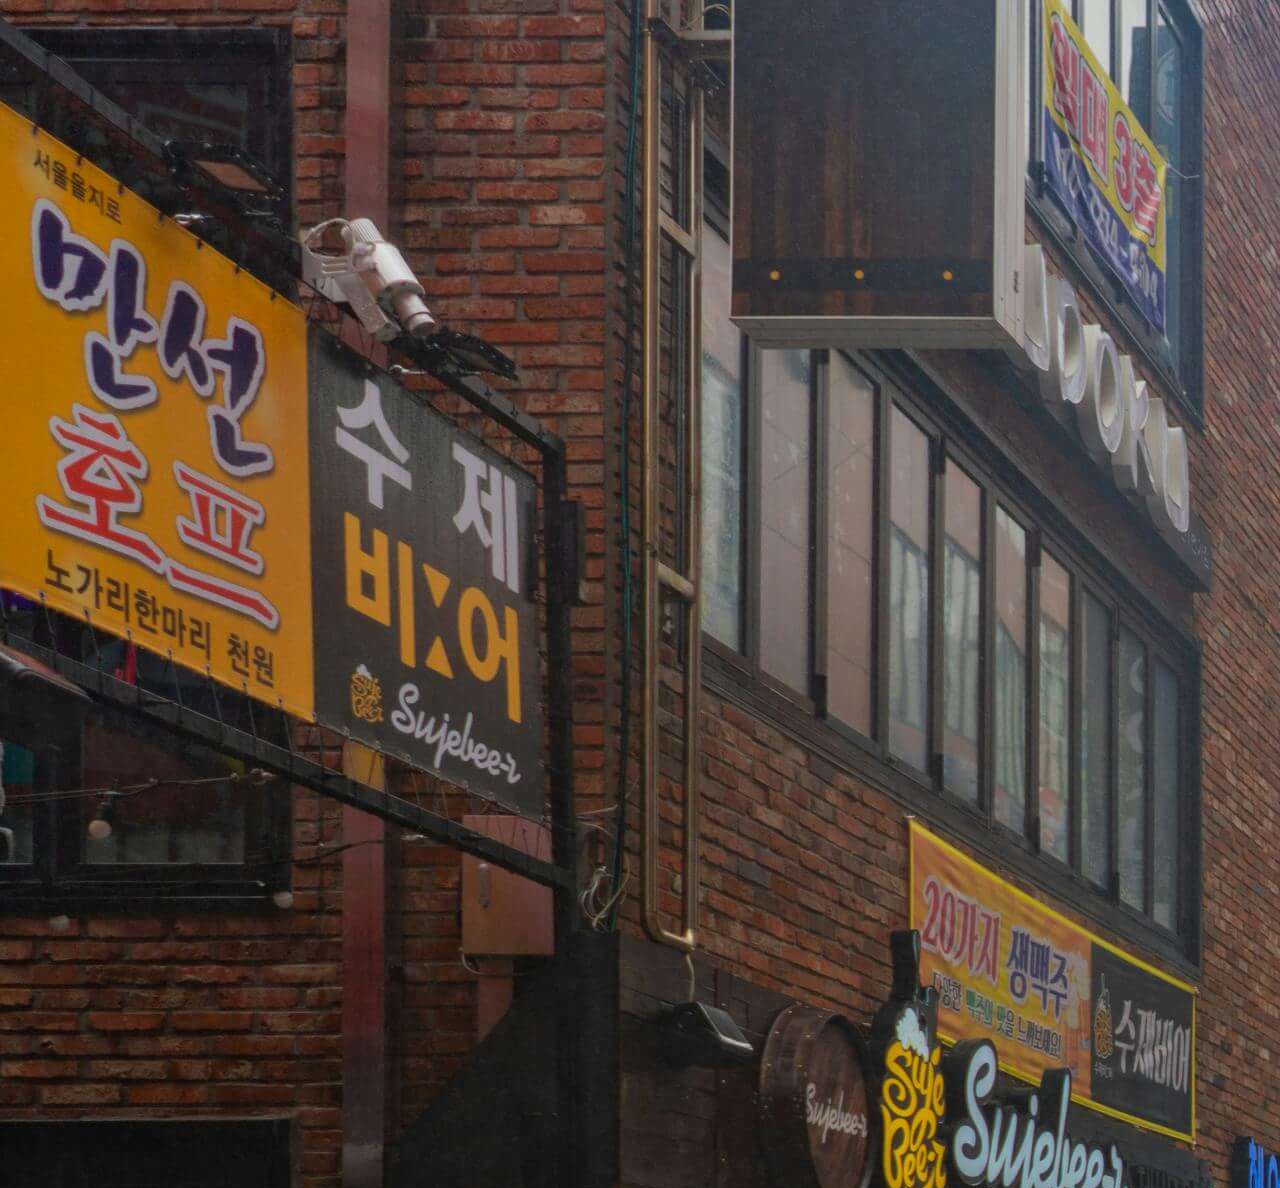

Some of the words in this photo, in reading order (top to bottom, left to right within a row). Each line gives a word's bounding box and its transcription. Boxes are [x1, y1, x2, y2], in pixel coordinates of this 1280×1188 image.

[32, 147, 123, 225] 서울을지로
[30, 198, 274, 477] 만선
[37, 404, 279, 630] 호프
[227, 632, 275, 690] 천원
[1006, 928, 1069, 1022] 생맥주
